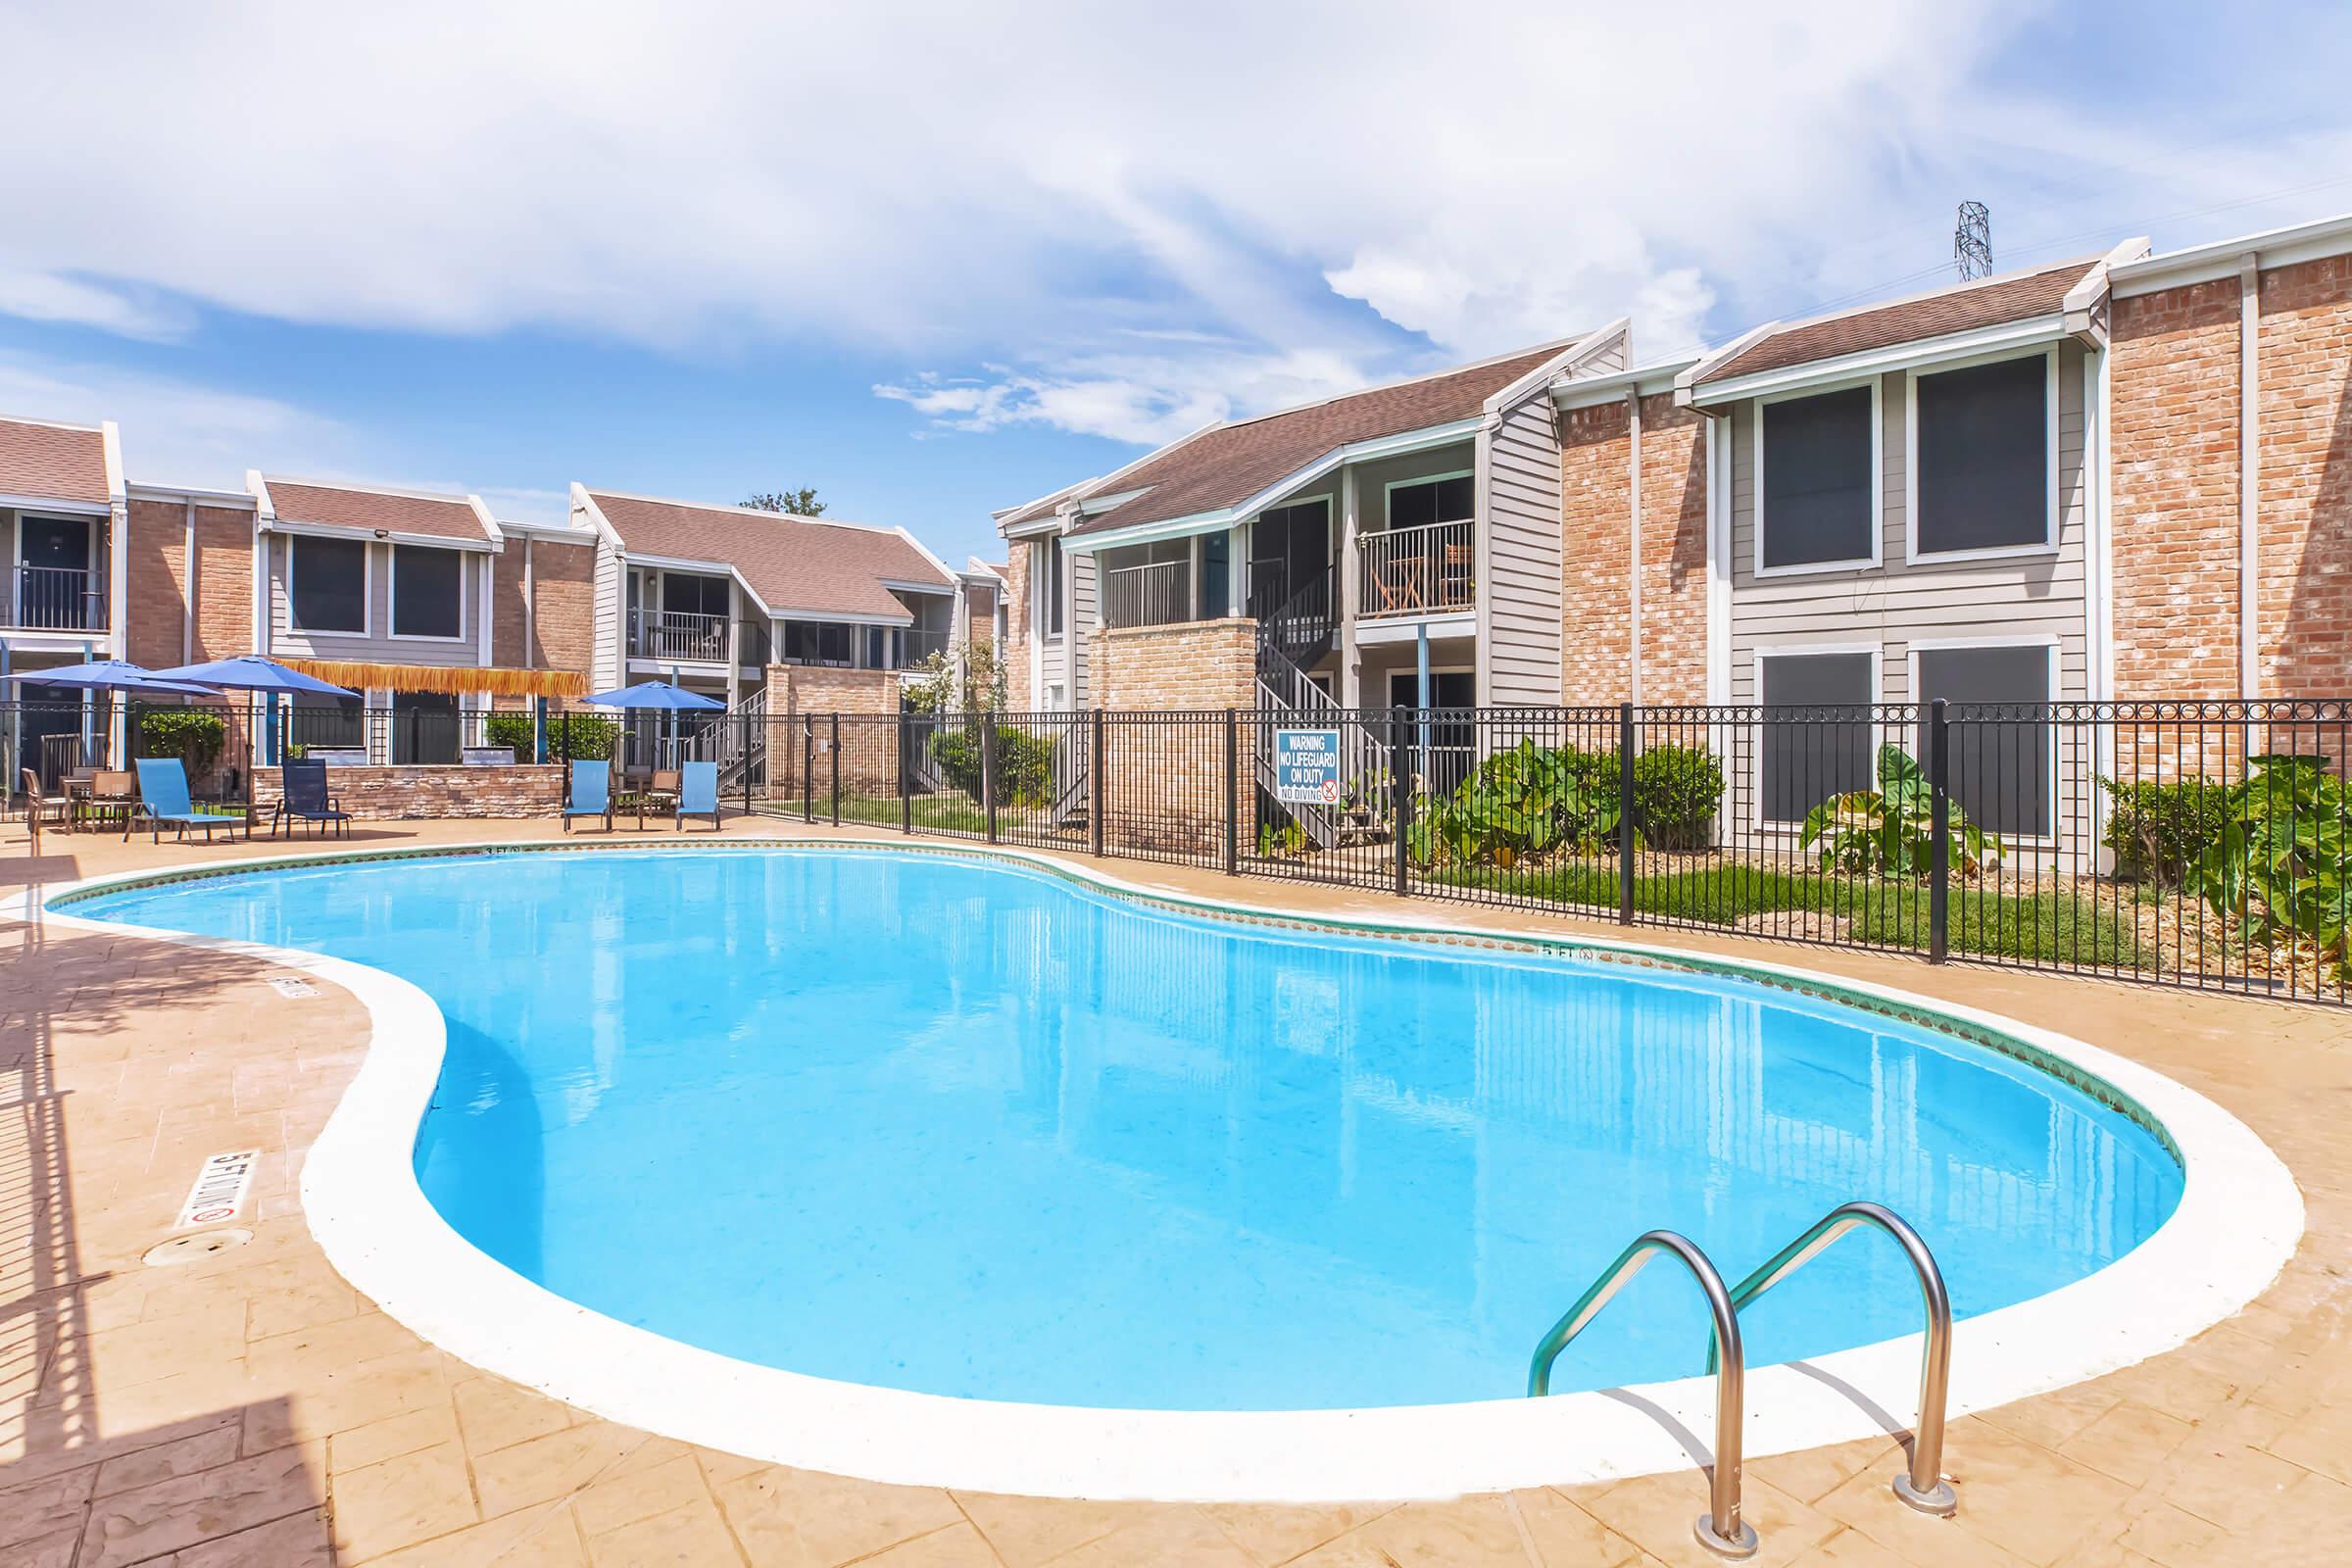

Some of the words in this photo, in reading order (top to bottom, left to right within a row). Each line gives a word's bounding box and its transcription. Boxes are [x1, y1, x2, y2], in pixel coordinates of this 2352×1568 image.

[1289, 736, 1325, 750] WARNING
[1280, 752, 1292, 766] NO
[1293, 753, 1336, 767] LIFEGUARD
[1291, 768, 1302, 783] ON
[1303, 768, 1324, 784] DUTY
[1282, 788, 1293, 799] NO
[1295, 789, 1322, 801] DIVING
[1543, 944, 1552, 956] 5
[1558, 946, 1575, 957] FT
[213, 1152, 252, 1163] 5
[204, 1163, 249, 1179] FT
